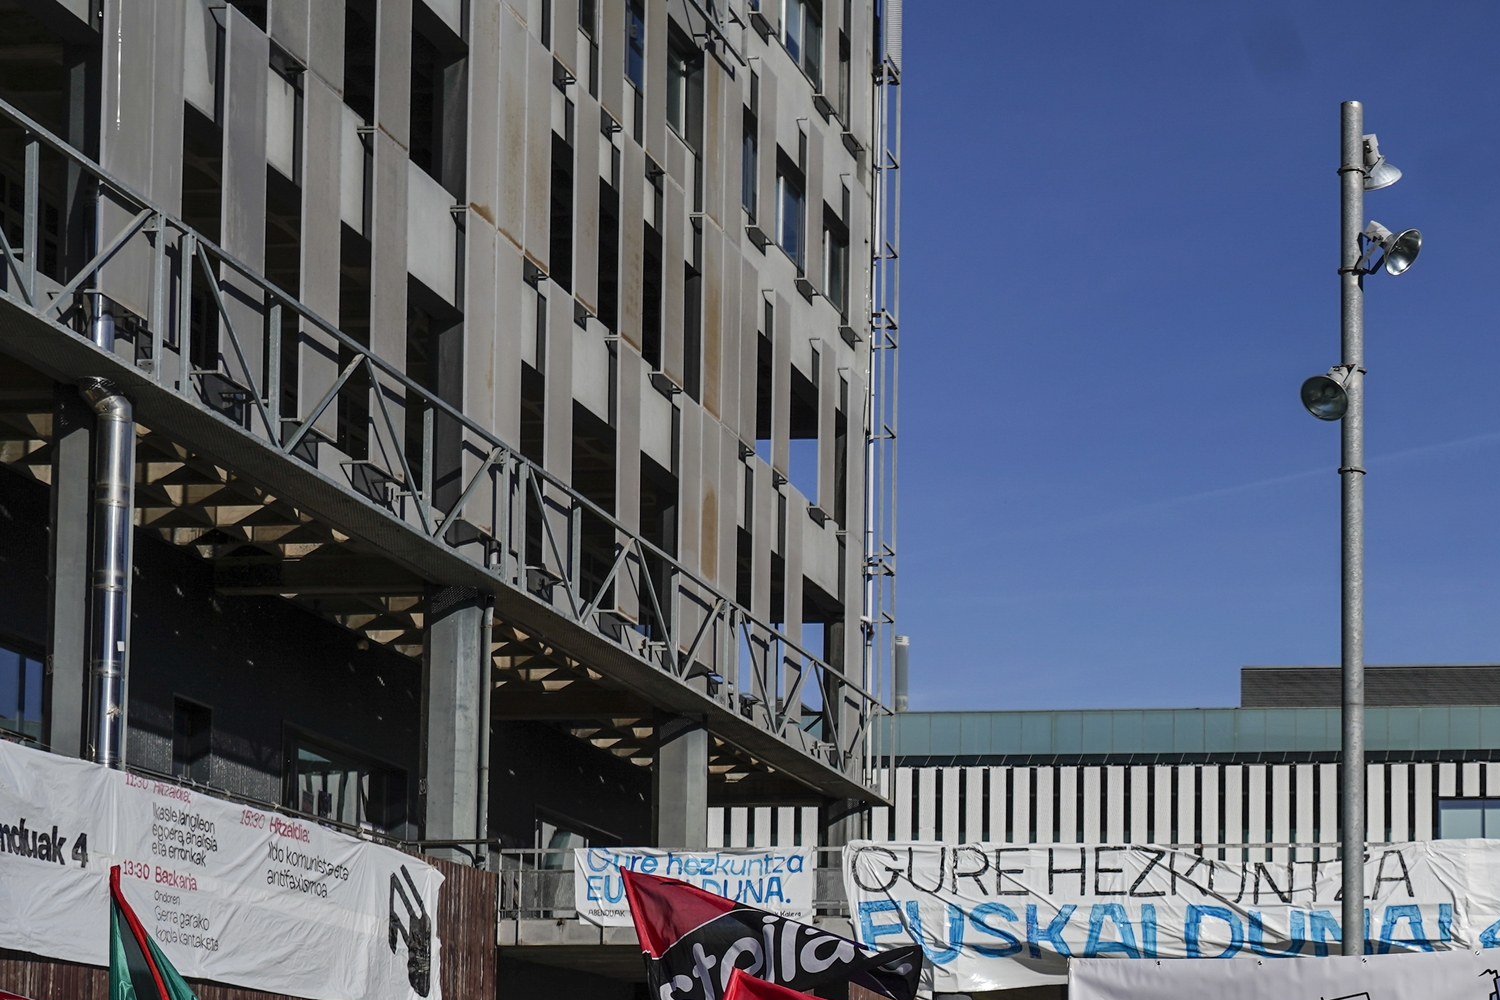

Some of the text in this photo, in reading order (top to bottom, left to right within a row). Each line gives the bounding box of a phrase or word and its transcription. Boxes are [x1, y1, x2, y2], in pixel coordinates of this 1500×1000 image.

[240, 810, 310, 843] 15:30 Hitzaldia:
[72, 833, 88, 868] 4
[588, 848, 803, 876] Gure hezkuntza
[123, 860, 197, 891] 13:30 Bazkaria
[333, 865, 349, 881] eta
[852, 845, 1029, 896] GURE
